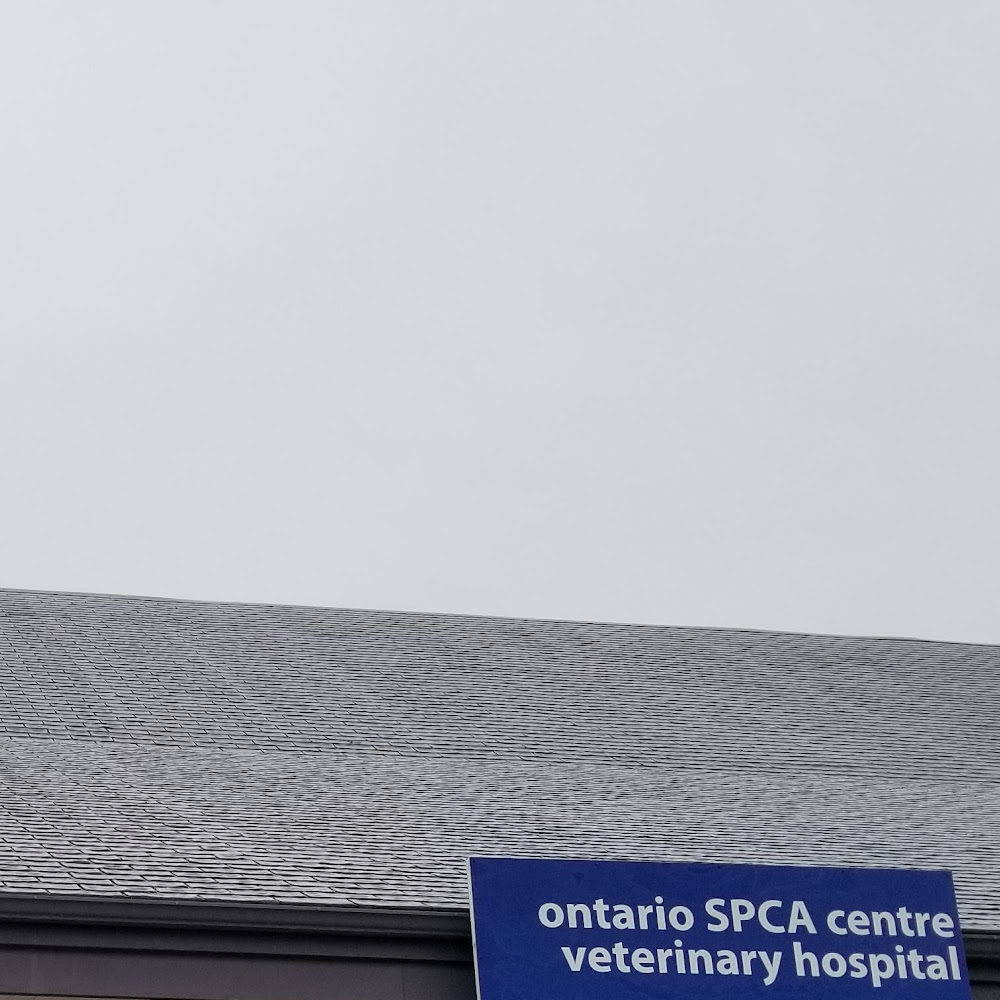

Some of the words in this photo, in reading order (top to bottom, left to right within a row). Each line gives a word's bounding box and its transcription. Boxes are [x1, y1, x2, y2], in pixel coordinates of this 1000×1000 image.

[539, 896, 694, 931] ontario
[705, 899, 817, 934] SPCA
[827, 907, 954, 938] centre
[561, 940, 782, 986] veterinary
[793, 942, 961, 987] hospital
